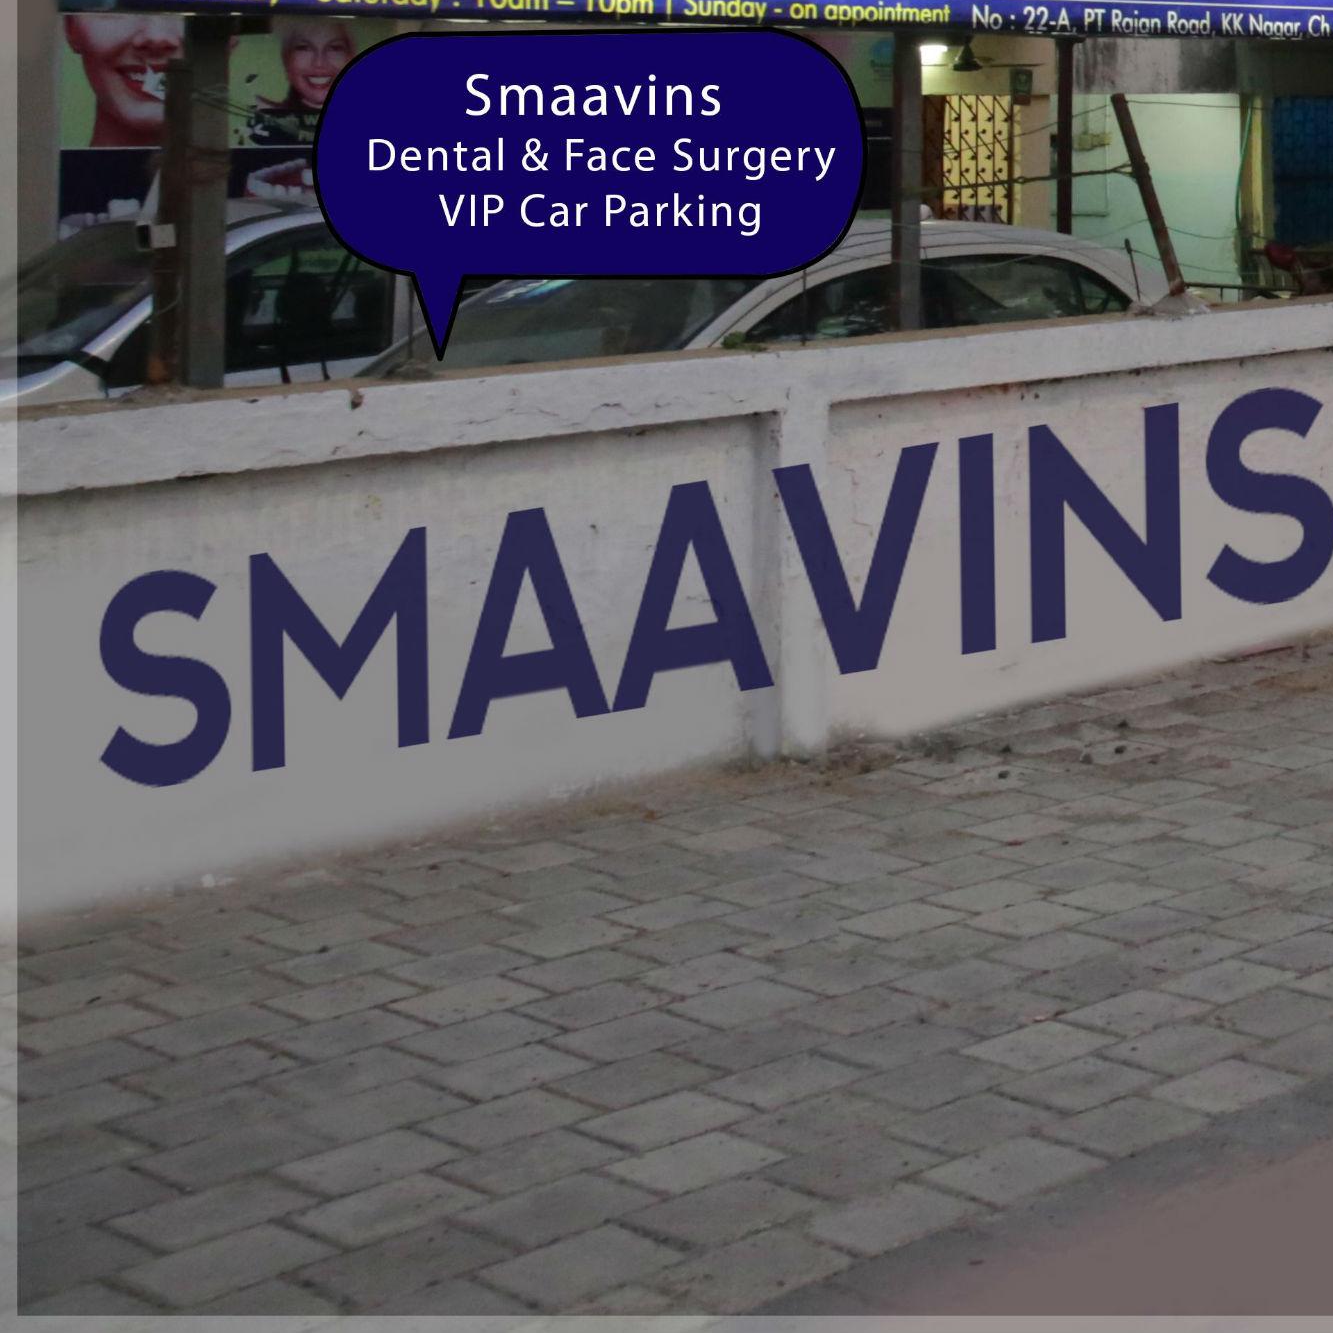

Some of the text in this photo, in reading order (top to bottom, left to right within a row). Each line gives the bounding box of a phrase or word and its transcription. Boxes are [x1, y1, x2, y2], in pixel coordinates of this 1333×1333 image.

[790, 3, 818, 19] on
[823, 2, 951, 25] appointment
[972, 6, 1002, 30] No
[1023, 6, 1077, 33] 22-A,
[1084, 10, 1106, 32] PT
[1167, 12, 1215, 36] Road,
[1222, 13, 1245, 34] KK
[1308, 14, 1330, 37] Ch
